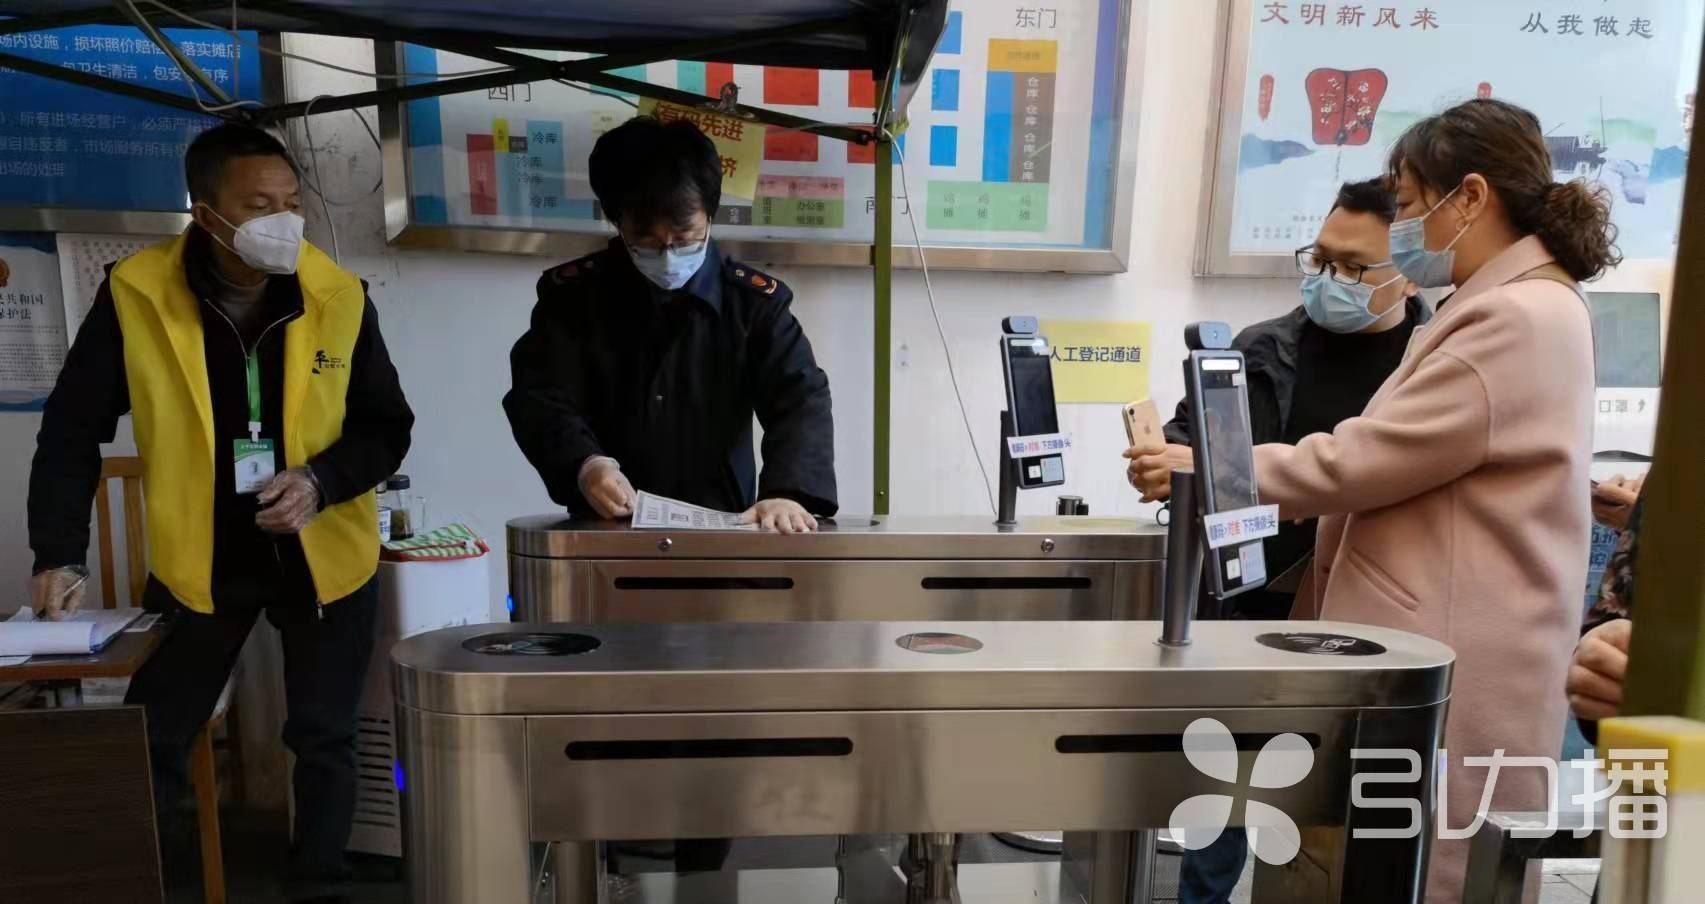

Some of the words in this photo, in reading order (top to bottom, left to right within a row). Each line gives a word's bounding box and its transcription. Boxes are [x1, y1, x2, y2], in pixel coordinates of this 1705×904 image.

[1015, 8, 1057, 29] 东门
[1260, 2, 1440, 30] 文明新风来
[1520, 12, 1655, 40] 从我做起
[1050, 346, 1141, 363] 人工登记通道
